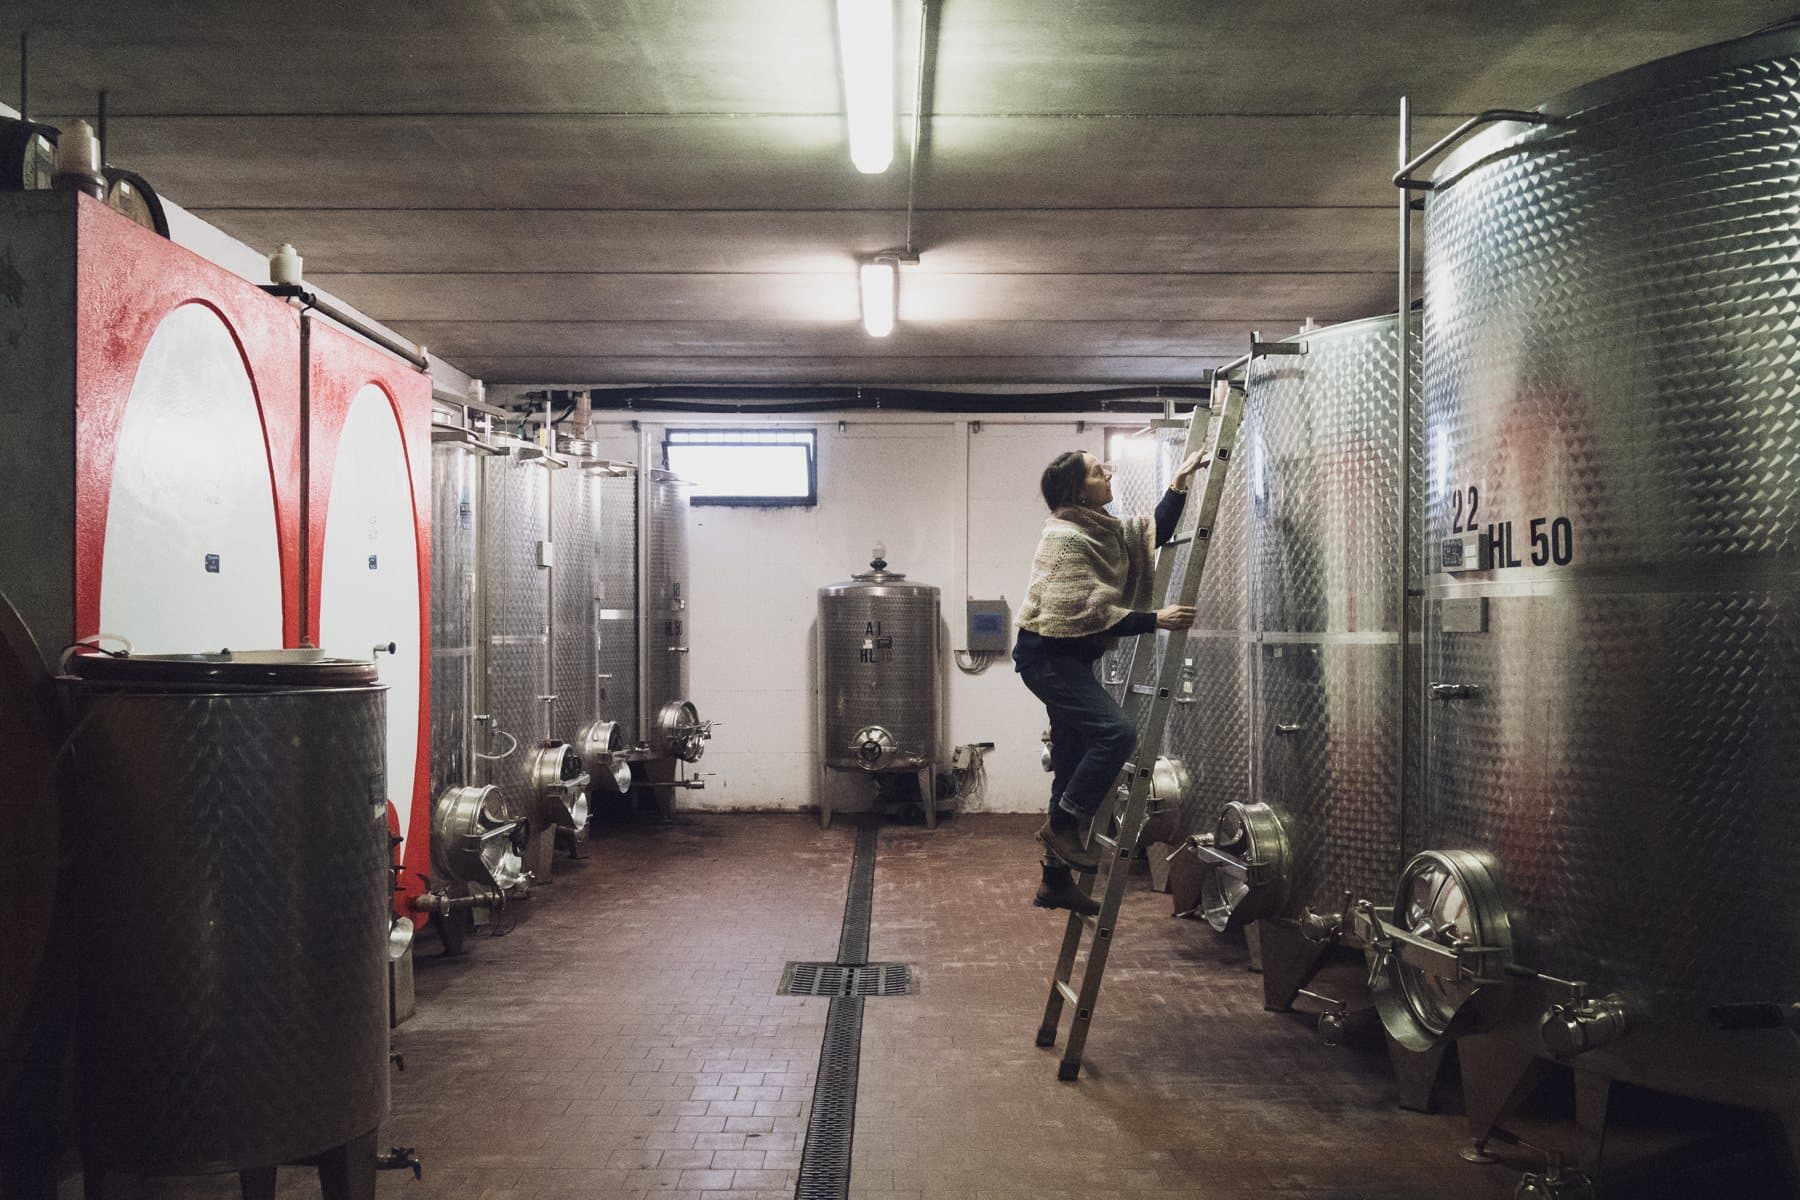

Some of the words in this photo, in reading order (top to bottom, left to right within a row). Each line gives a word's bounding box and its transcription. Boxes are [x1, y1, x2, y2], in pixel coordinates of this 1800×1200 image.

[1452, 486, 1479, 534] 22
[1487, 520, 1522, 570] HL
[1530, 516, 1573, 567] 50
